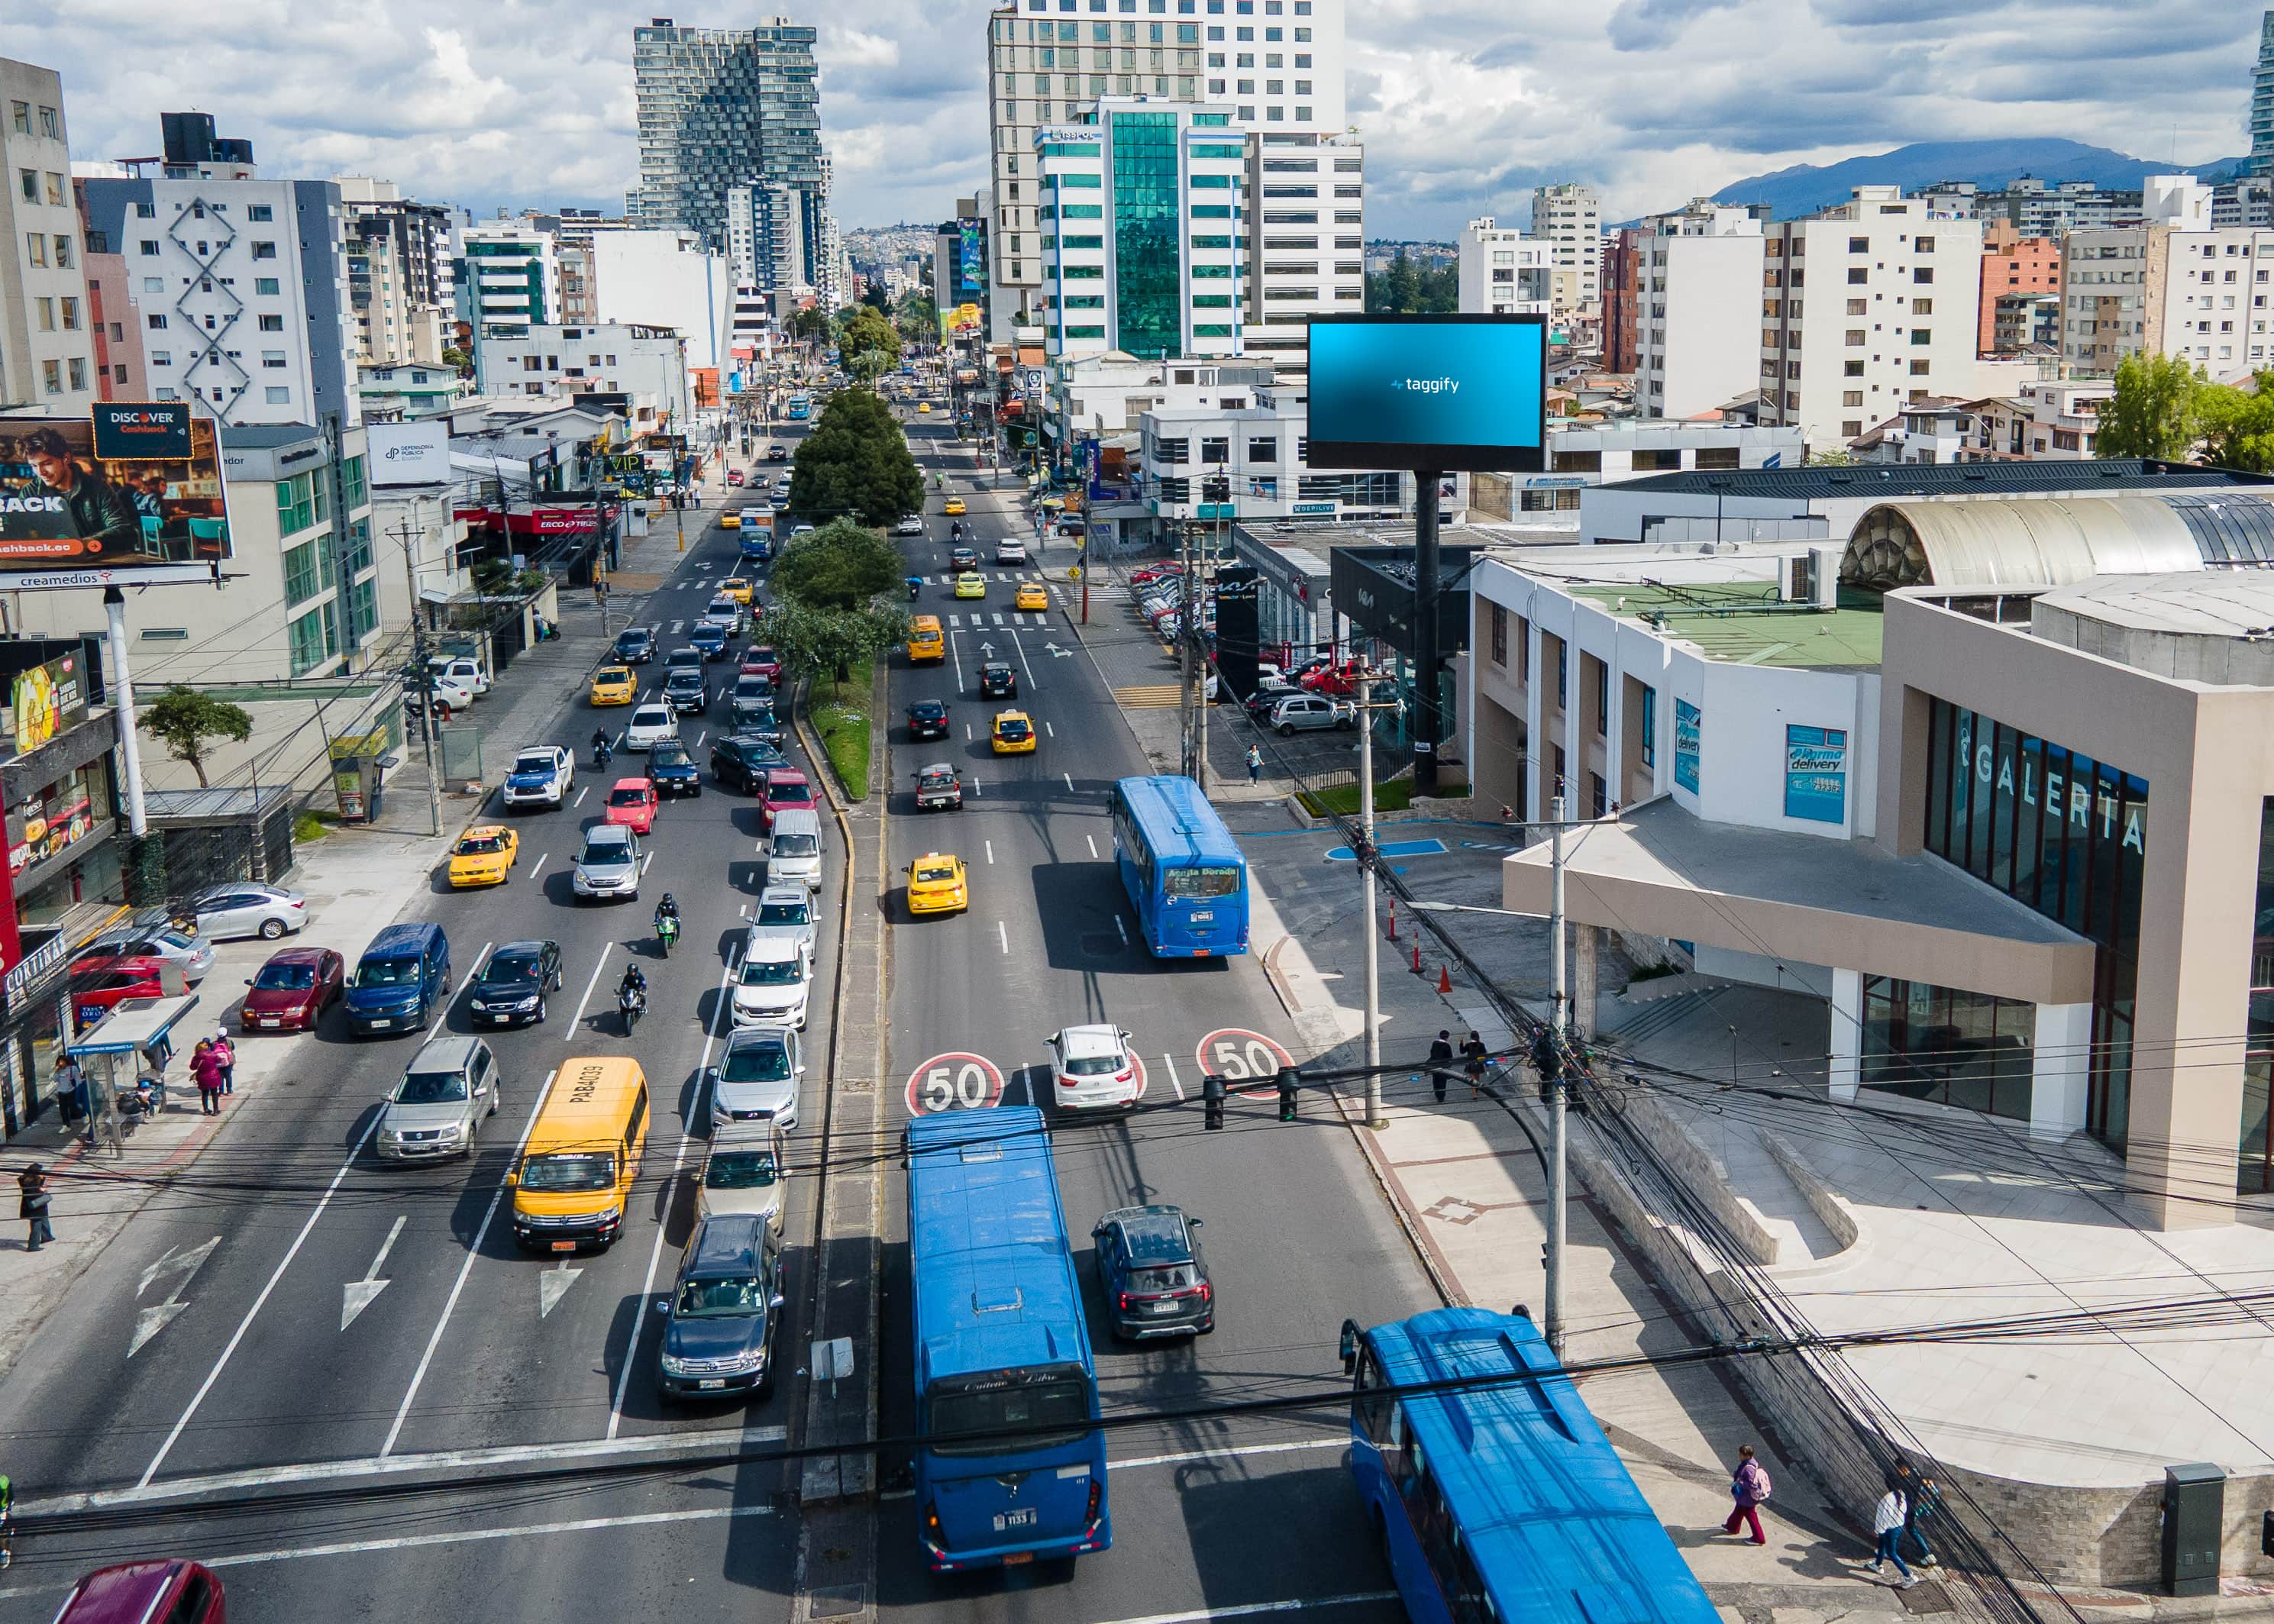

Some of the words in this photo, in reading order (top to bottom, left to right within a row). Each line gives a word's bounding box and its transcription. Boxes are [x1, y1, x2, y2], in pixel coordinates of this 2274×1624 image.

[1406, 376, 1459, 394] taggify
[111, 412, 174, 423] DISCOVER
[613, 457, 639, 471] VIP
[21, 573, 98, 586] creamedios
[1791, 759, 1840, 771] delivery
[1214, 1040, 1279, 1078] 50
[569, 1066, 603, 1103] PAB4039
[925, 1063, 990, 1111] 50
[1007, 1514, 1027, 1526] 1133
